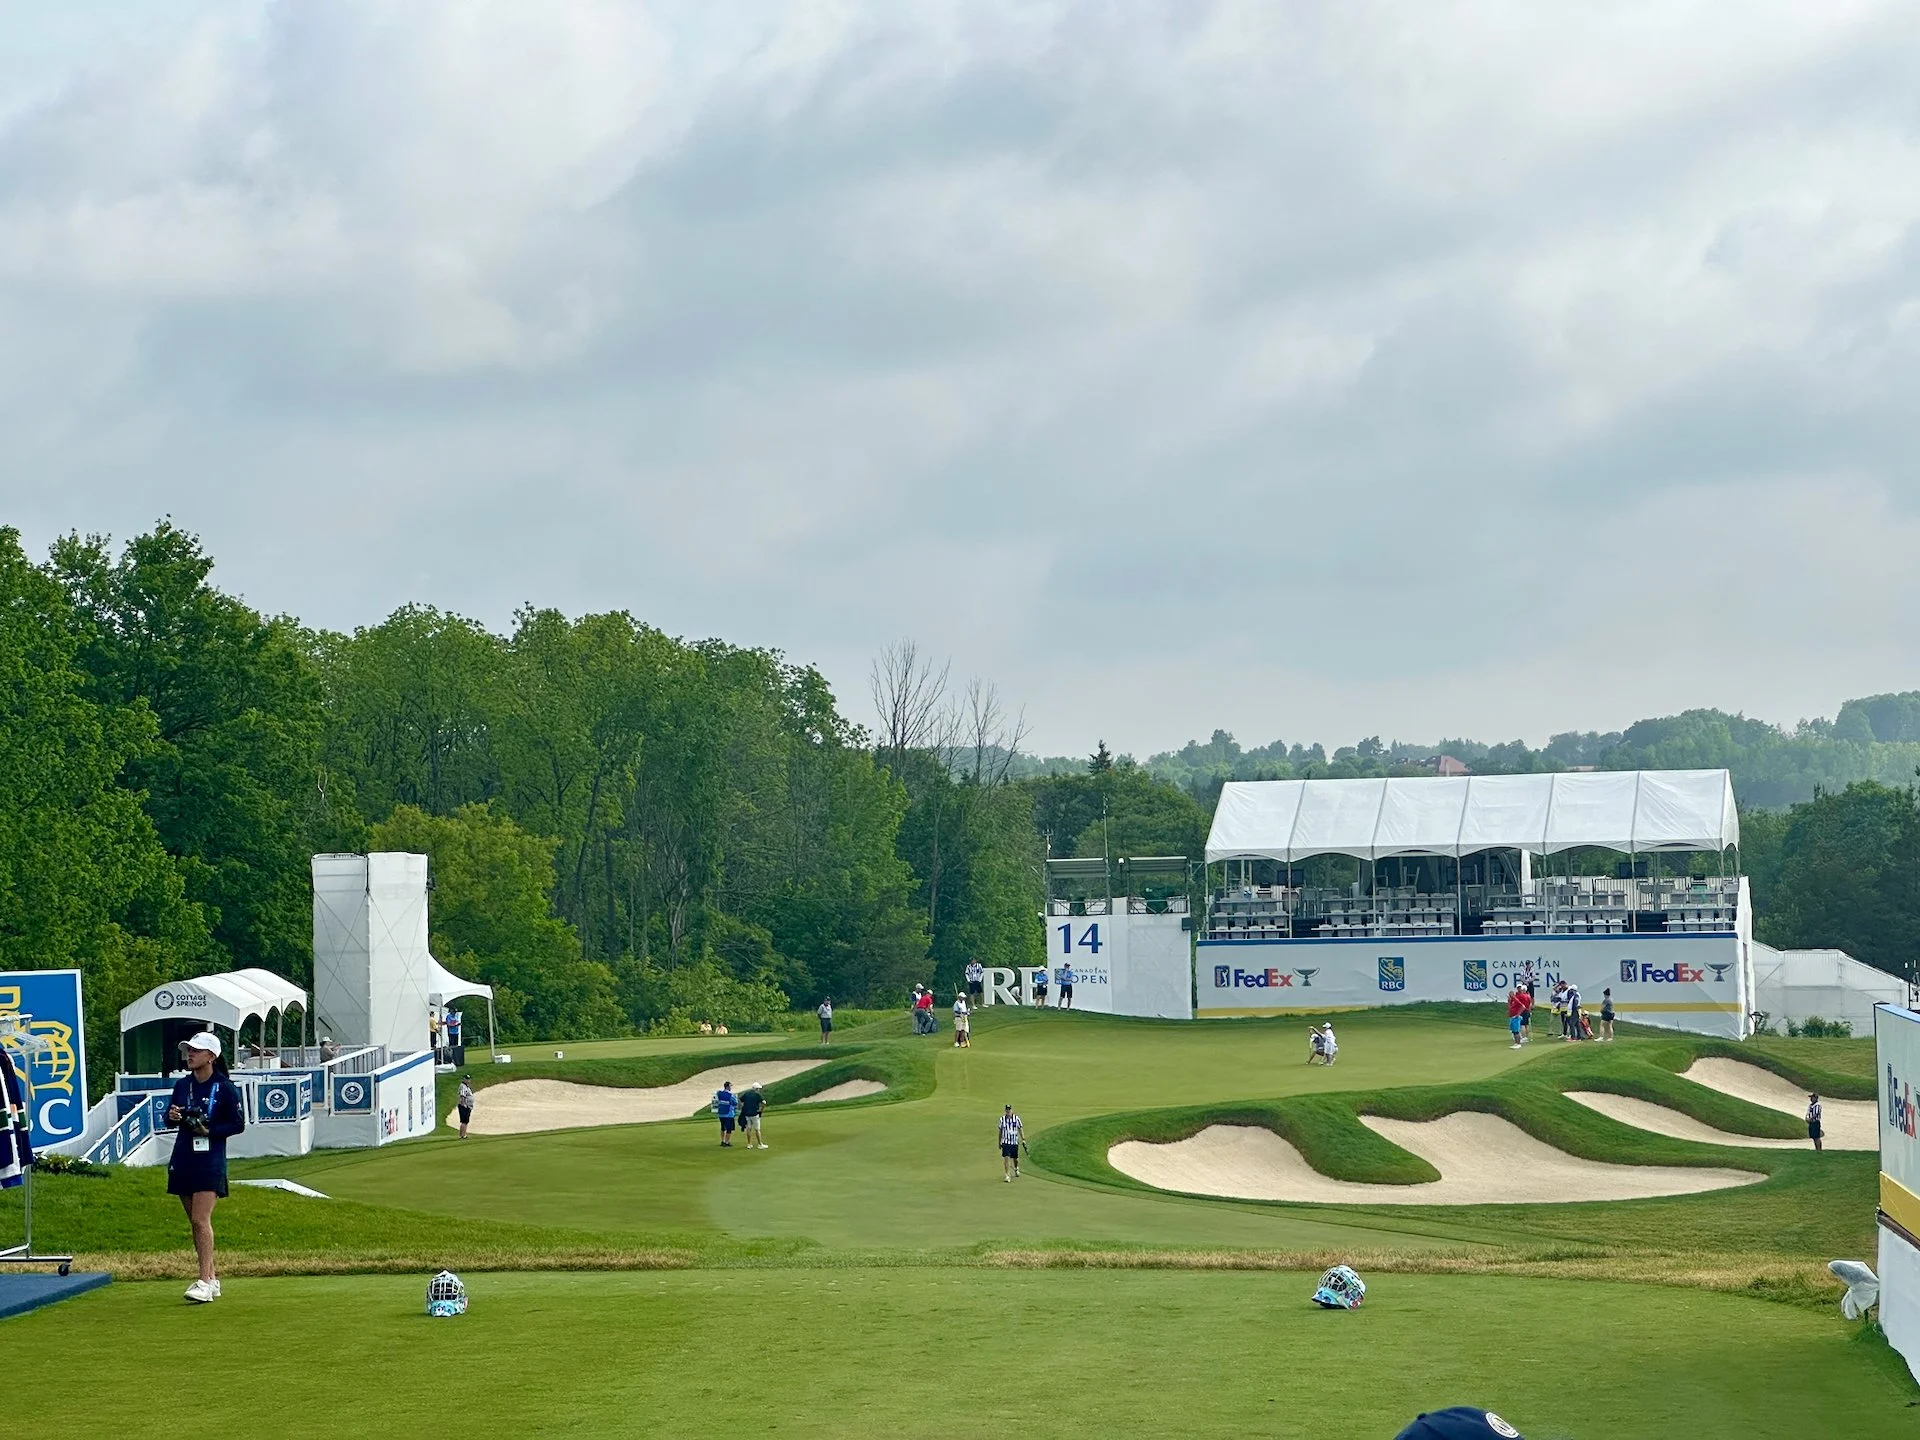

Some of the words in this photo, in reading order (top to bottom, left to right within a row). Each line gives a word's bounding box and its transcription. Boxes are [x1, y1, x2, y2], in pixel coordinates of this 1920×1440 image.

[1057, 923, 1103, 954] 14
[1234, 968, 1293, 987] FedEx
[1641, 963, 1704, 982] FedEx
[1381, 981, 1403, 990] RBC
[1466, 981, 1486, 990] RBC
